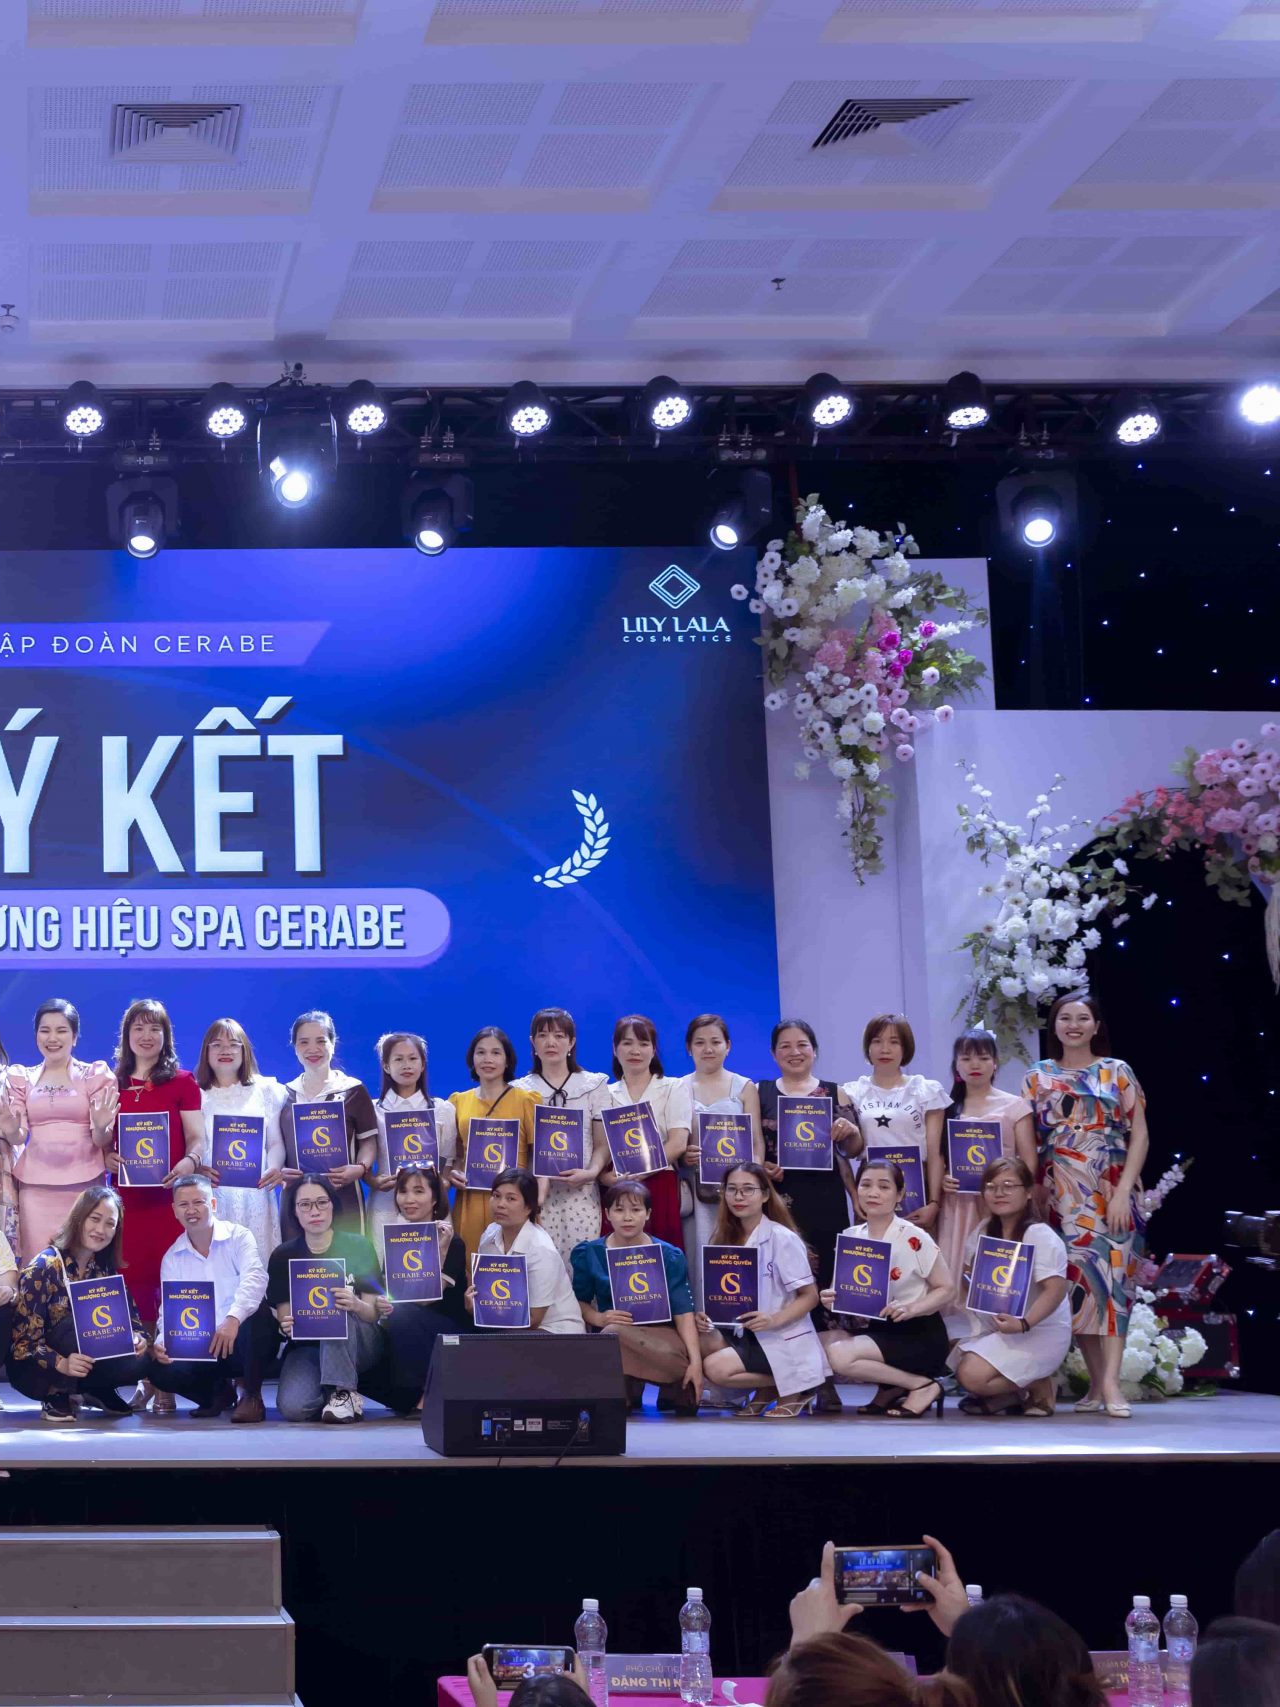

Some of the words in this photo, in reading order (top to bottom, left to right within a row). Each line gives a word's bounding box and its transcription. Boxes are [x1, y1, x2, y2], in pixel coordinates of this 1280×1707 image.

[622, 617, 667, 632] LILY
[672, 617, 730, 632] LALA
[51, 631, 137, 653] ĐOÀN
[154, 635, 275, 652] CERABE
[623, 635, 732, 643] COSMETICS
[101, 696, 344, 875] KẾT
[72, 898, 159, 955] HIỆU
[171, 904, 245, 949] SPA
[255, 904, 404, 949] CERABE
[841, 1284, 868, 1293] CERABE
[620, 1294, 648, 1302] CERABE
[83, 1327, 111, 1338] CERABE
[113, 1325, 125, 1333] SPA
[523, 1662, 535, 1678] 3
